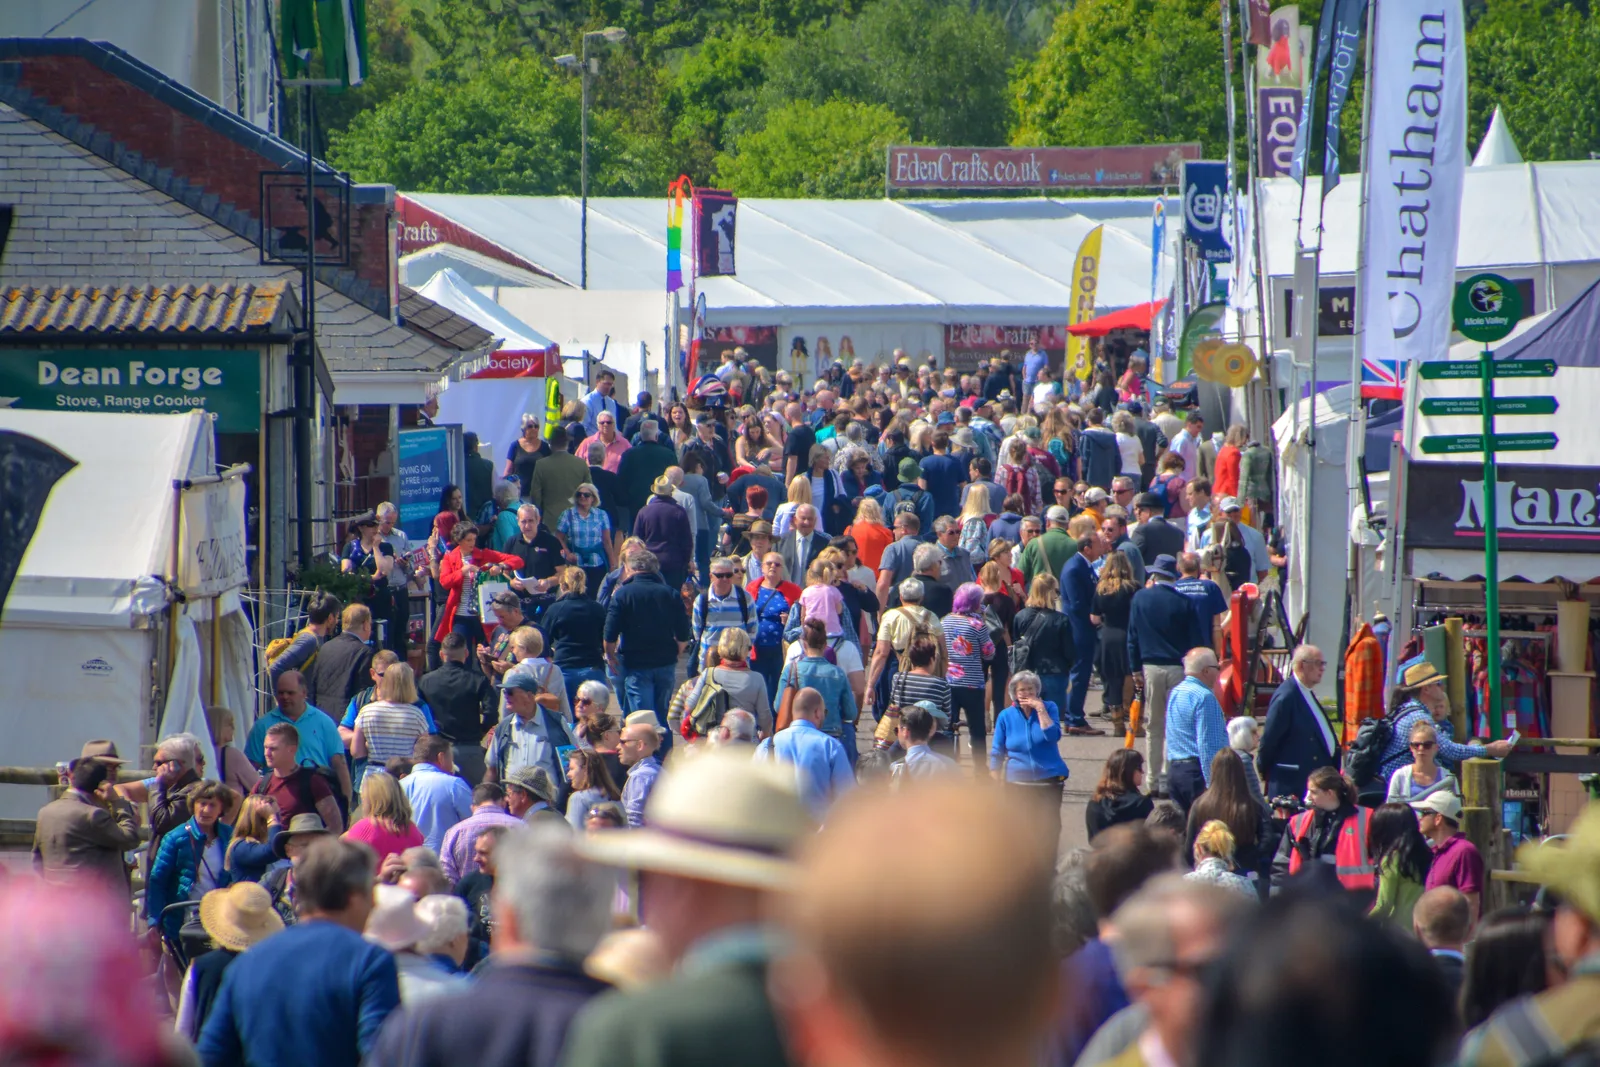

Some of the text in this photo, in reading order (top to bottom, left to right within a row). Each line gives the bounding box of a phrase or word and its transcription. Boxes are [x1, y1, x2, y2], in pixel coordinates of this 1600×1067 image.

[895, 152, 1042, 182] EdenCrafts.co.uk
[1386, 9, 1447, 340] Chatham
[1464, 316, 1508, 326] Mole Valley
[489, 355, 534, 371] ociety
[38, 360, 223, 391] Dean Forge
[56, 393, 207, 408] Stove, Range Cooker
[400, 464, 431, 475] RIVING ON
[405, 476, 420, 485] FREE
[400, 486, 421, 498] esigned
[422, 484, 432, 494] for
[1455, 479, 1600, 528] Man
